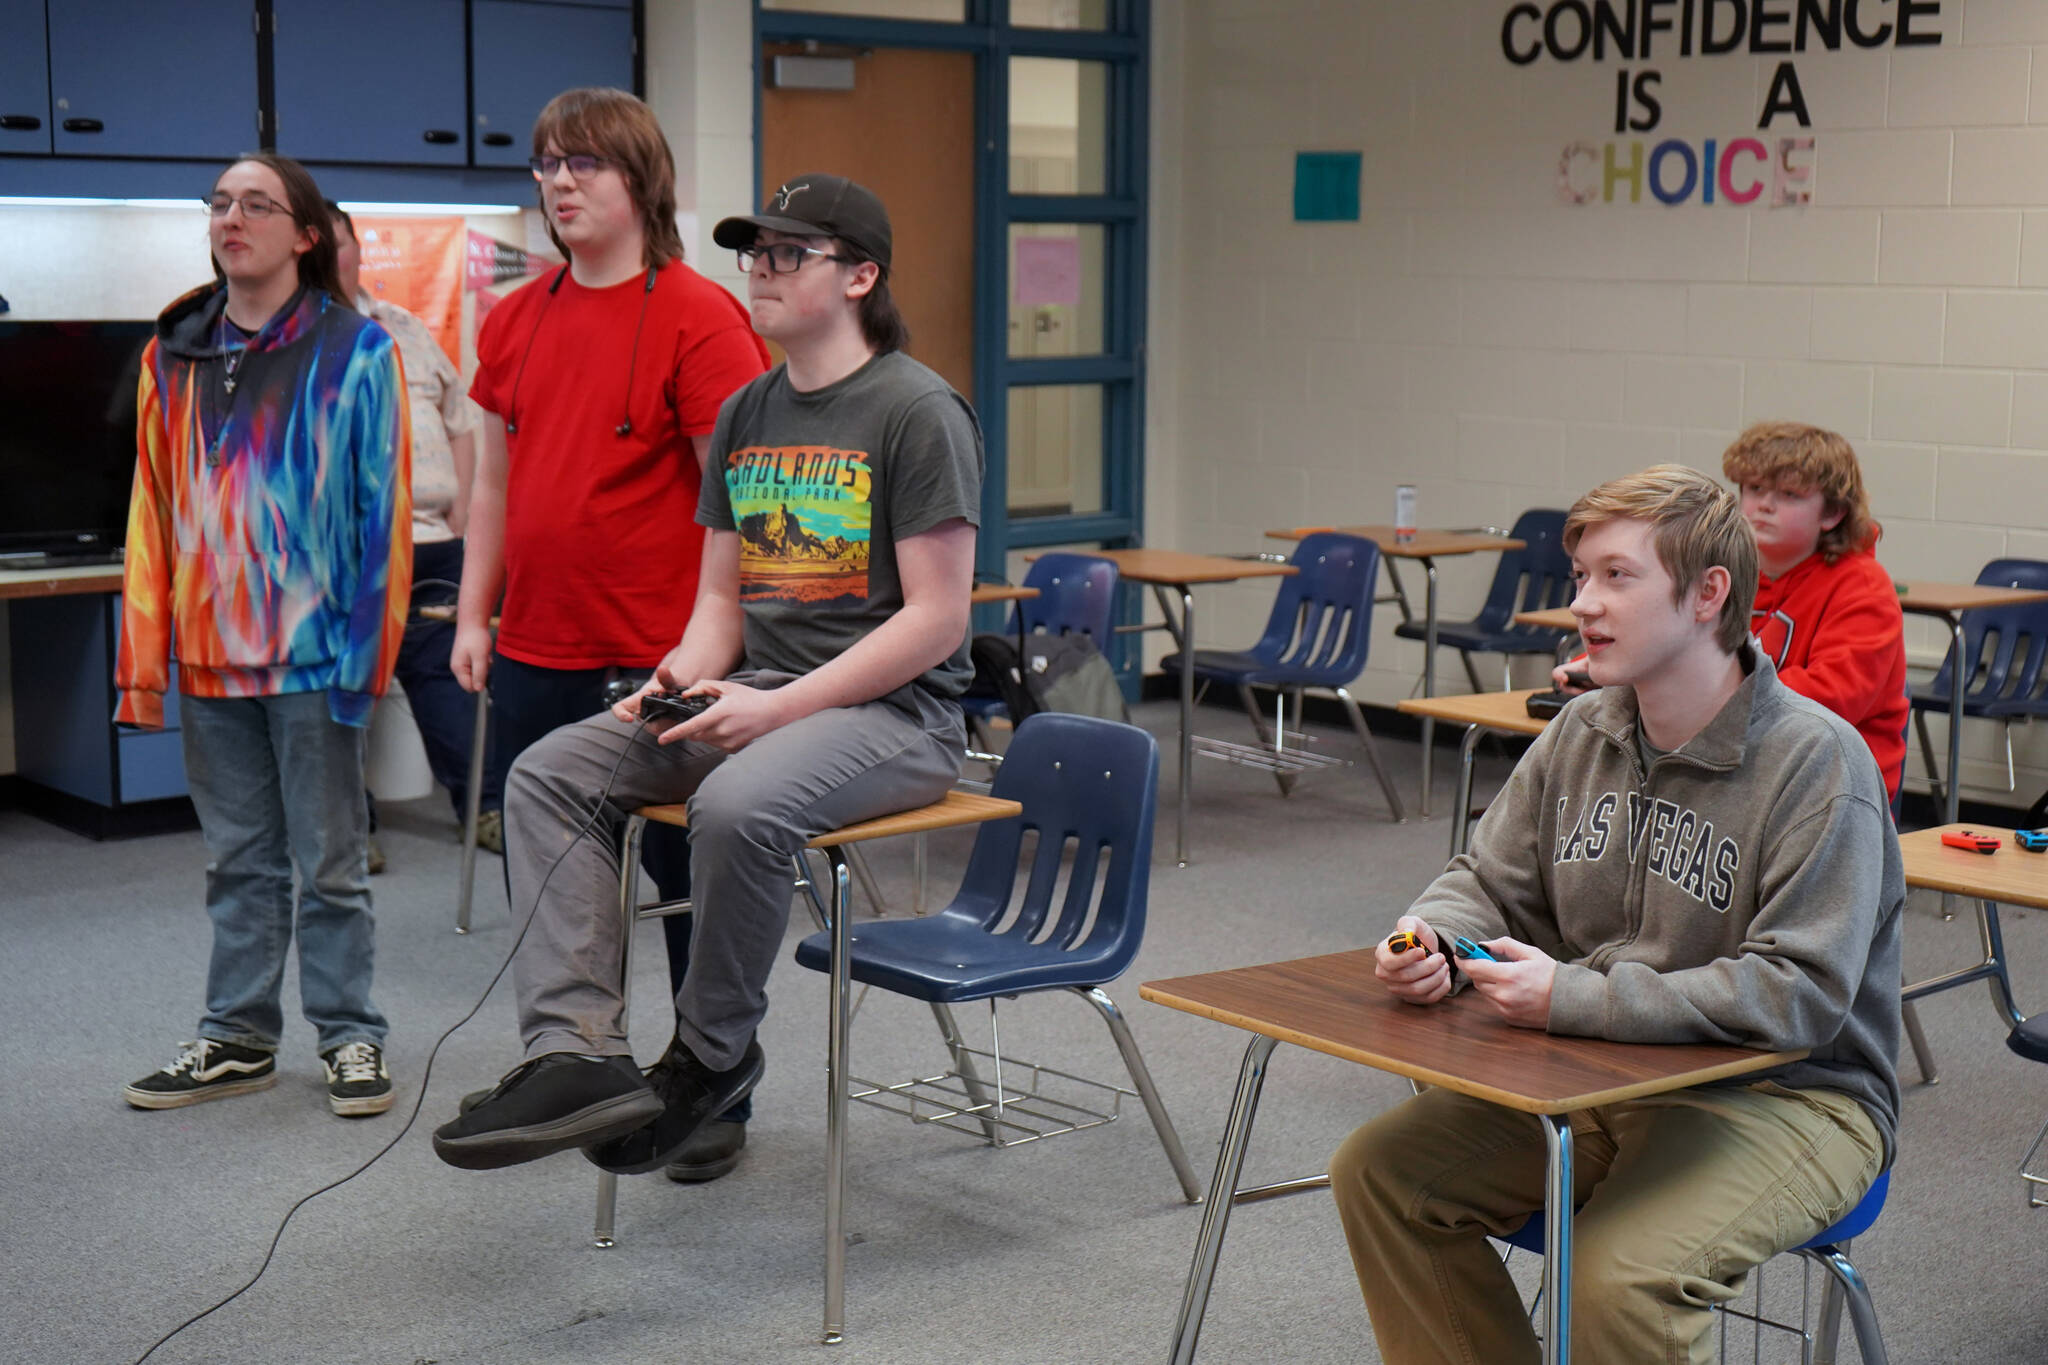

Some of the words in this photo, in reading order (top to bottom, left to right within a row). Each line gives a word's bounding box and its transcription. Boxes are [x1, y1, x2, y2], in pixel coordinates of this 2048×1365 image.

[1501, 0, 1942, 65] CONFIDENCE
[1615, 69, 1662, 133] IS
[1757, 62, 1812, 128] A
[1557, 137, 1815, 206] CHOICE
[805, 487, 840, 502] PARK
[1553, 791, 1619, 866] LAS
[1626, 791, 1740, 914] VEGAS
